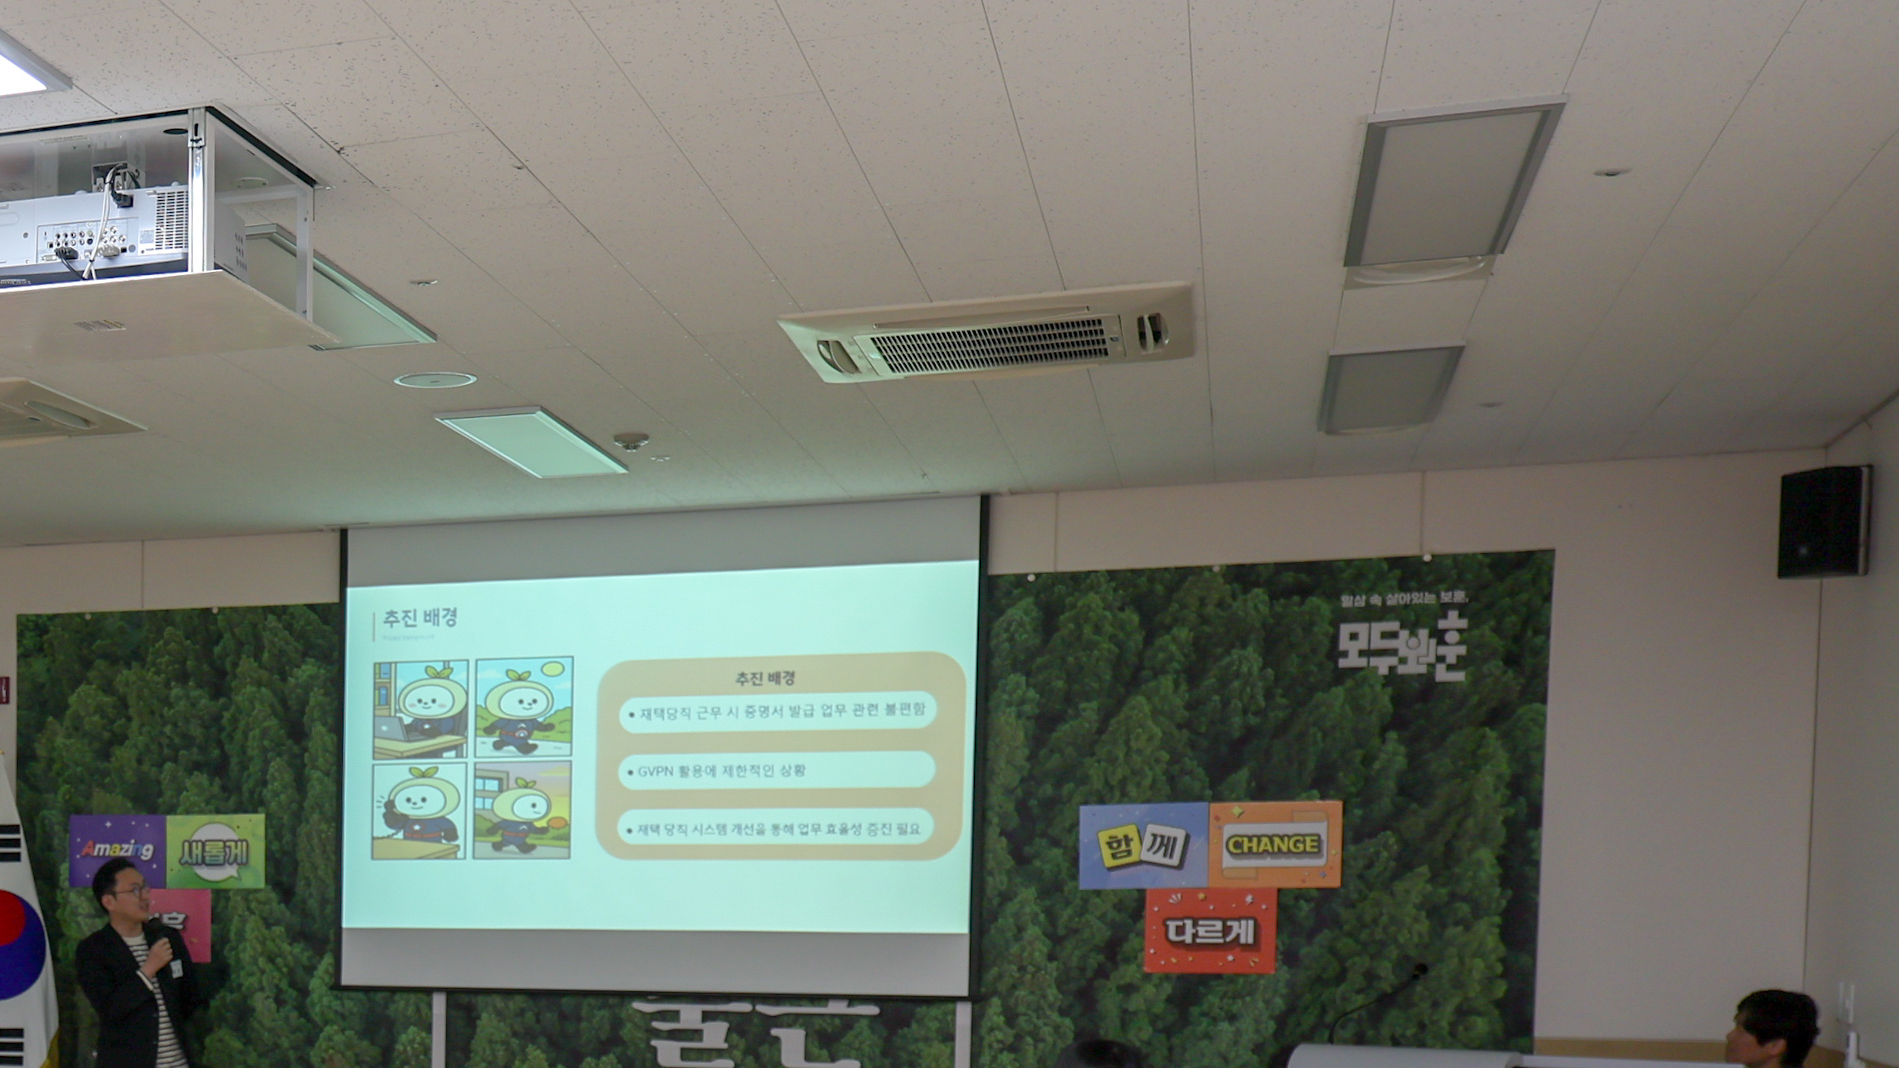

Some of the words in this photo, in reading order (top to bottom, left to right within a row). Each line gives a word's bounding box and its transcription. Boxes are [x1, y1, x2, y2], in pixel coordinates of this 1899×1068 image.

[1386, 591, 1437, 606] 살아있는
[383, 608, 418, 629] 추진
[423, 606, 458, 628] 배경
[735, 671, 764, 687] 추진
[767, 670, 796, 686] 배경
[640, 706, 692, 722] 재택당직
[696, 705, 723, 721] 근무
[727, 704, 740, 720] 시
[789, 704, 816, 719] 발급
[821, 703, 848, 719] 업무
[852, 702, 879, 718] 관련
[885, 701, 927, 718] 불편함
[638, 765, 675, 778] GVPN
[678, 764, 717, 779] 활용에
[722, 764, 775, 778] 제한적인
[780, 763, 807, 778] 상황
[638, 823, 661, 837] 재택
[664, 823, 689, 838] 당직
[692, 823, 728, 837] 시스템
[731, 822, 767, 837] 개선을
[770, 822, 795, 837] 통해
[798, 822, 823, 837] 업무
[826, 822, 863, 837] 효율성
[867, 822, 893, 838] 증진
[897, 822, 921, 837] 필요
[81, 838, 155, 861] Amazing
[179, 839, 248, 867] 새롭게
[1105, 832, 1179, 862] 함께
[1226, 833, 1322, 856] CHANGE
[1164, 917, 1256, 947] 다르게
